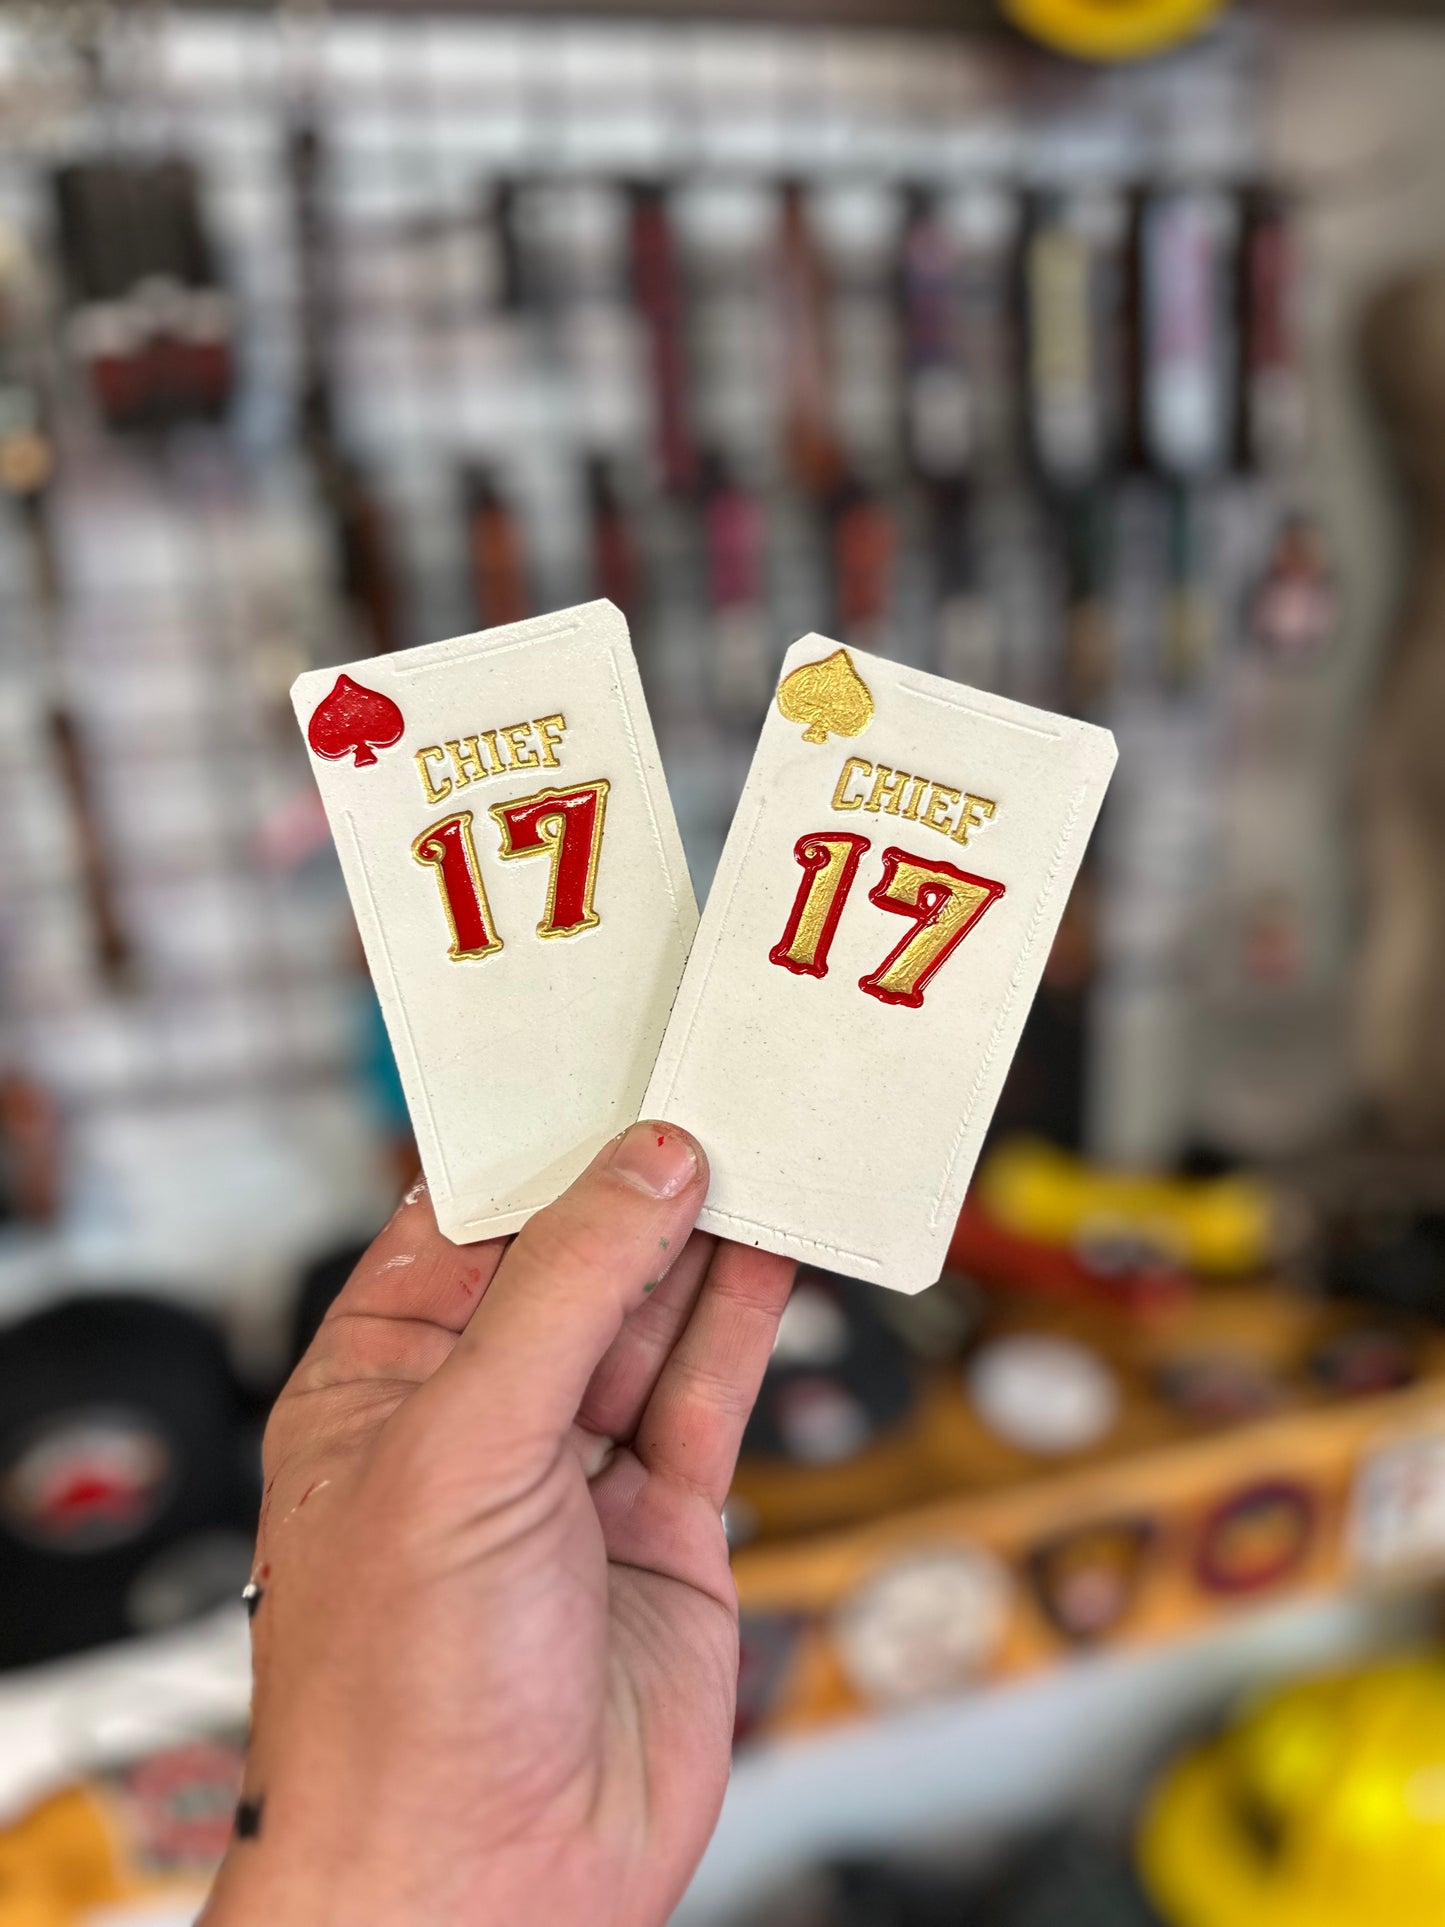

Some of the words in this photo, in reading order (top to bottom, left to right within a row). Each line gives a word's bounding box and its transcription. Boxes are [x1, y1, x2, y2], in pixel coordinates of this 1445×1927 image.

[414, 714, 566, 803] CHIEF
[831, 756, 996, 846] CHIEF
[411, 779, 610, 962] 17
[769, 832, 1005, 1008] 17
